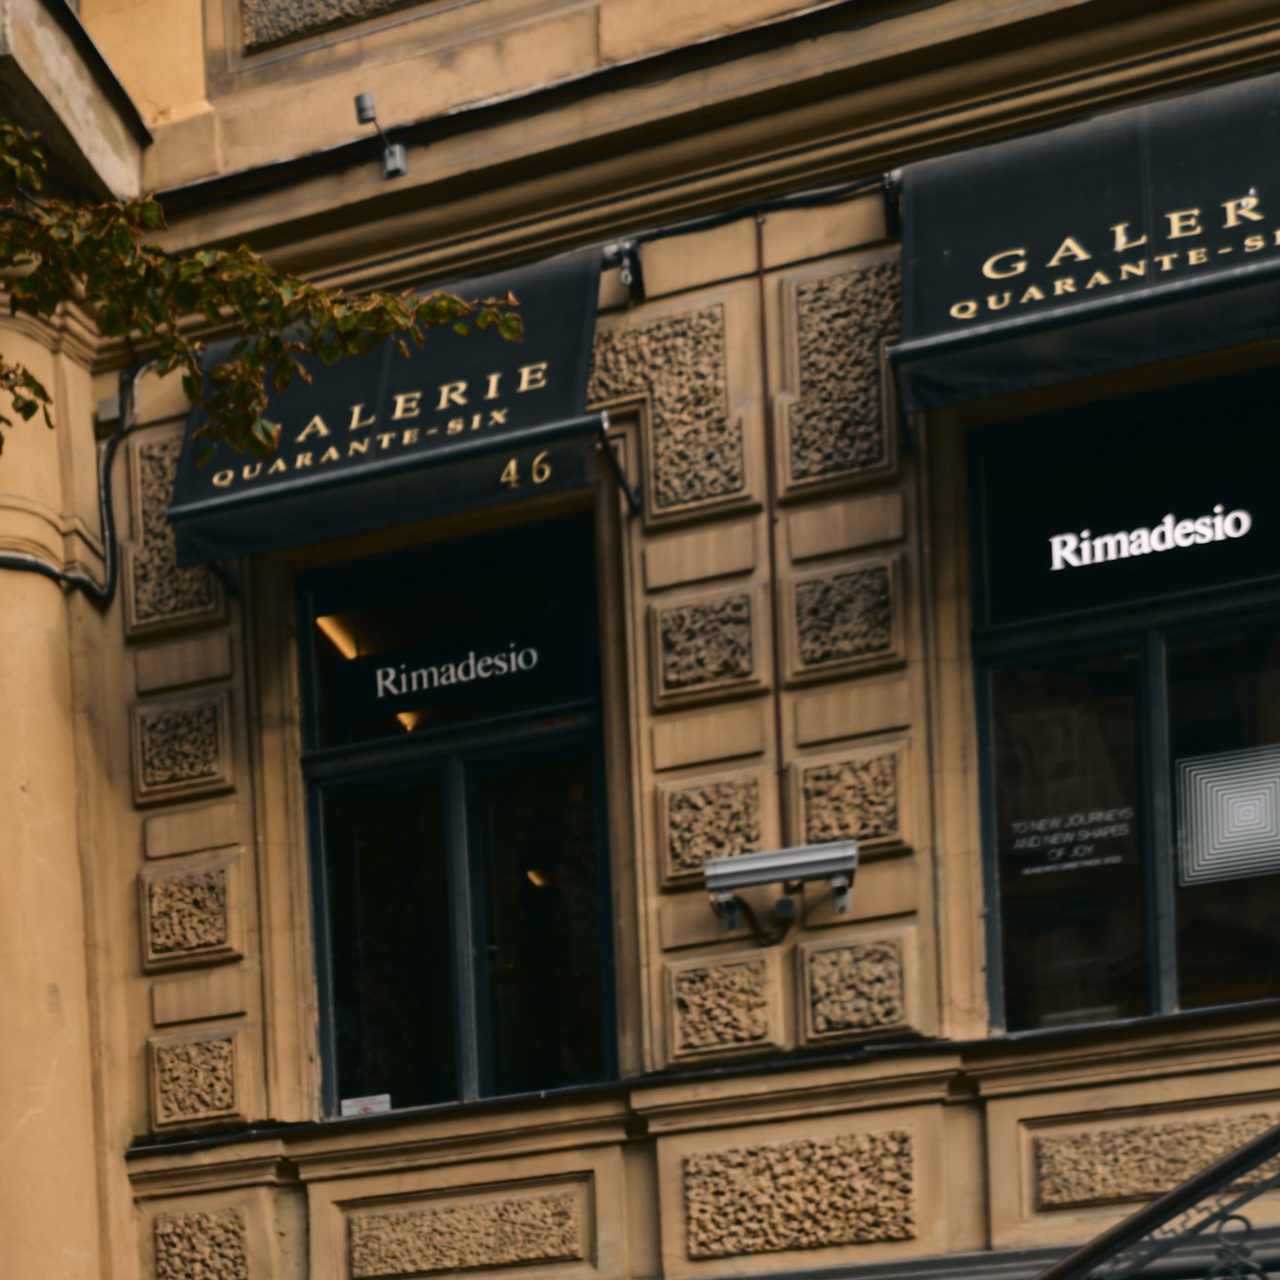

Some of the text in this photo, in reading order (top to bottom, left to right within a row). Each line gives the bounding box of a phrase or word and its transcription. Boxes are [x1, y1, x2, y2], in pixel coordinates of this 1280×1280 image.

[276, 361, 549, 444] ALERIE
[211, 408, 510, 488] QUARANTE-SIX
[500, 451, 552, 489] 46
[1048, 503, 1252, 571] Rimadesio
[375, 642, 538, 698] Rimadesio
